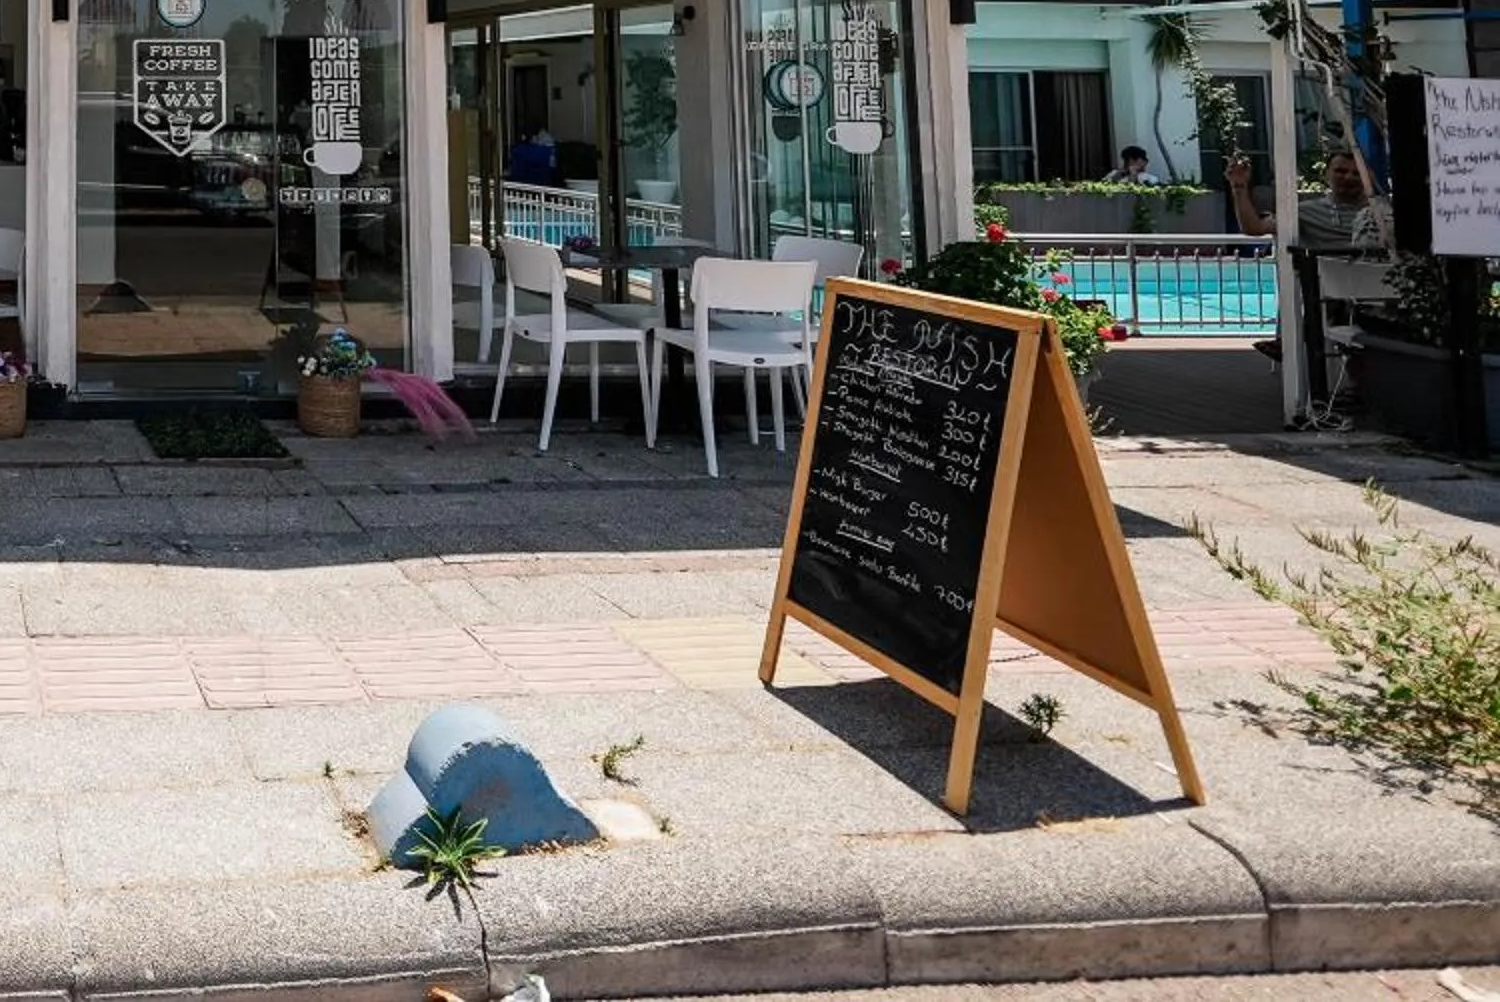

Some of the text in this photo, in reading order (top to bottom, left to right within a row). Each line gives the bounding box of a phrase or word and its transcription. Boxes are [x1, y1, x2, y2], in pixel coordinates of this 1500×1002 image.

[149, 45, 212, 58] FRESH
[143, 59, 218, 72] COFFEE
[145, 81, 216, 92] TAKE
[145, 93, 218, 108] AWAY
